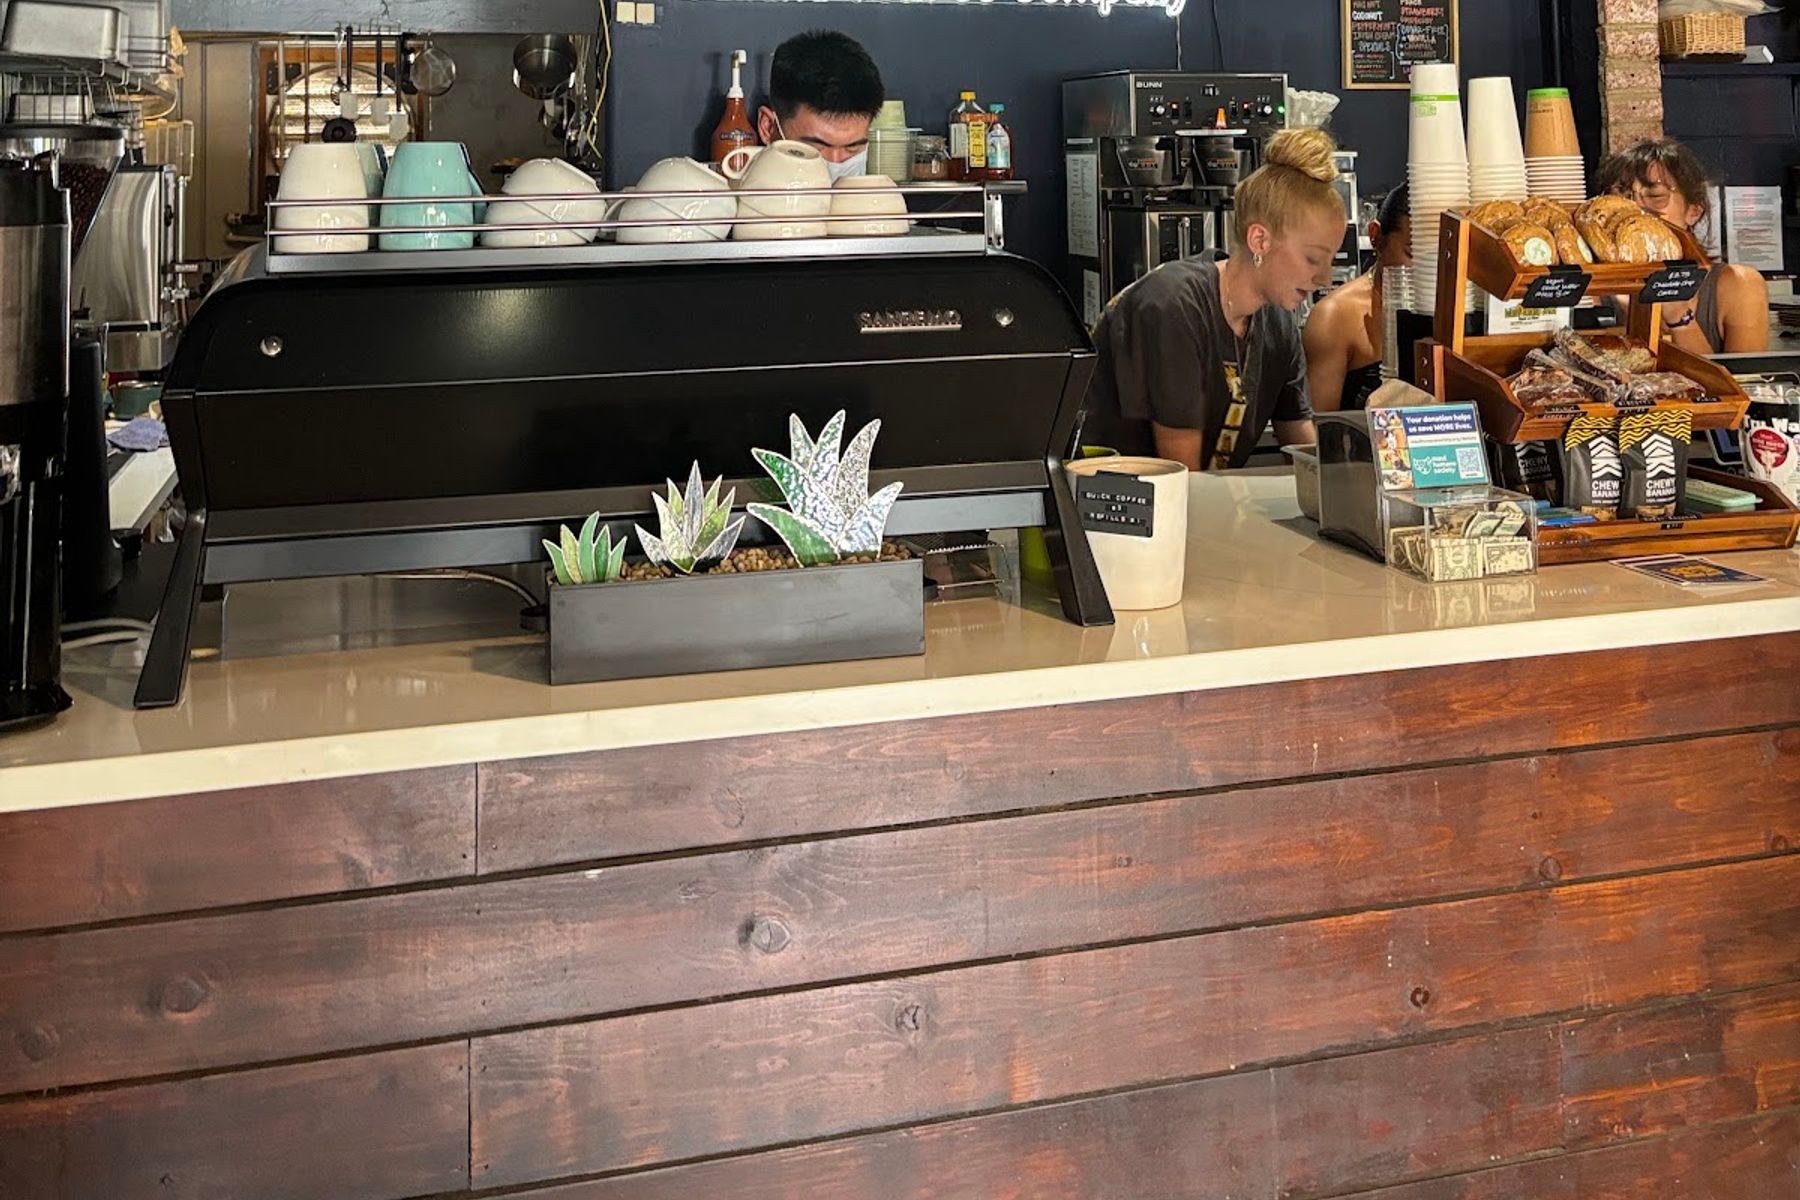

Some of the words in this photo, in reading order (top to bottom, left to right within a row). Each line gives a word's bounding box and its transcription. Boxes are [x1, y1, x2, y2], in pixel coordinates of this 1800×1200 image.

[1136, 81, 1163, 89] BUNN
[1406, 416, 1421, 424] Your
[1423, 414, 1453, 423] donation
[1454, 413, 1472, 422] helps
[1646, 477, 1675, 489] CHEWY
